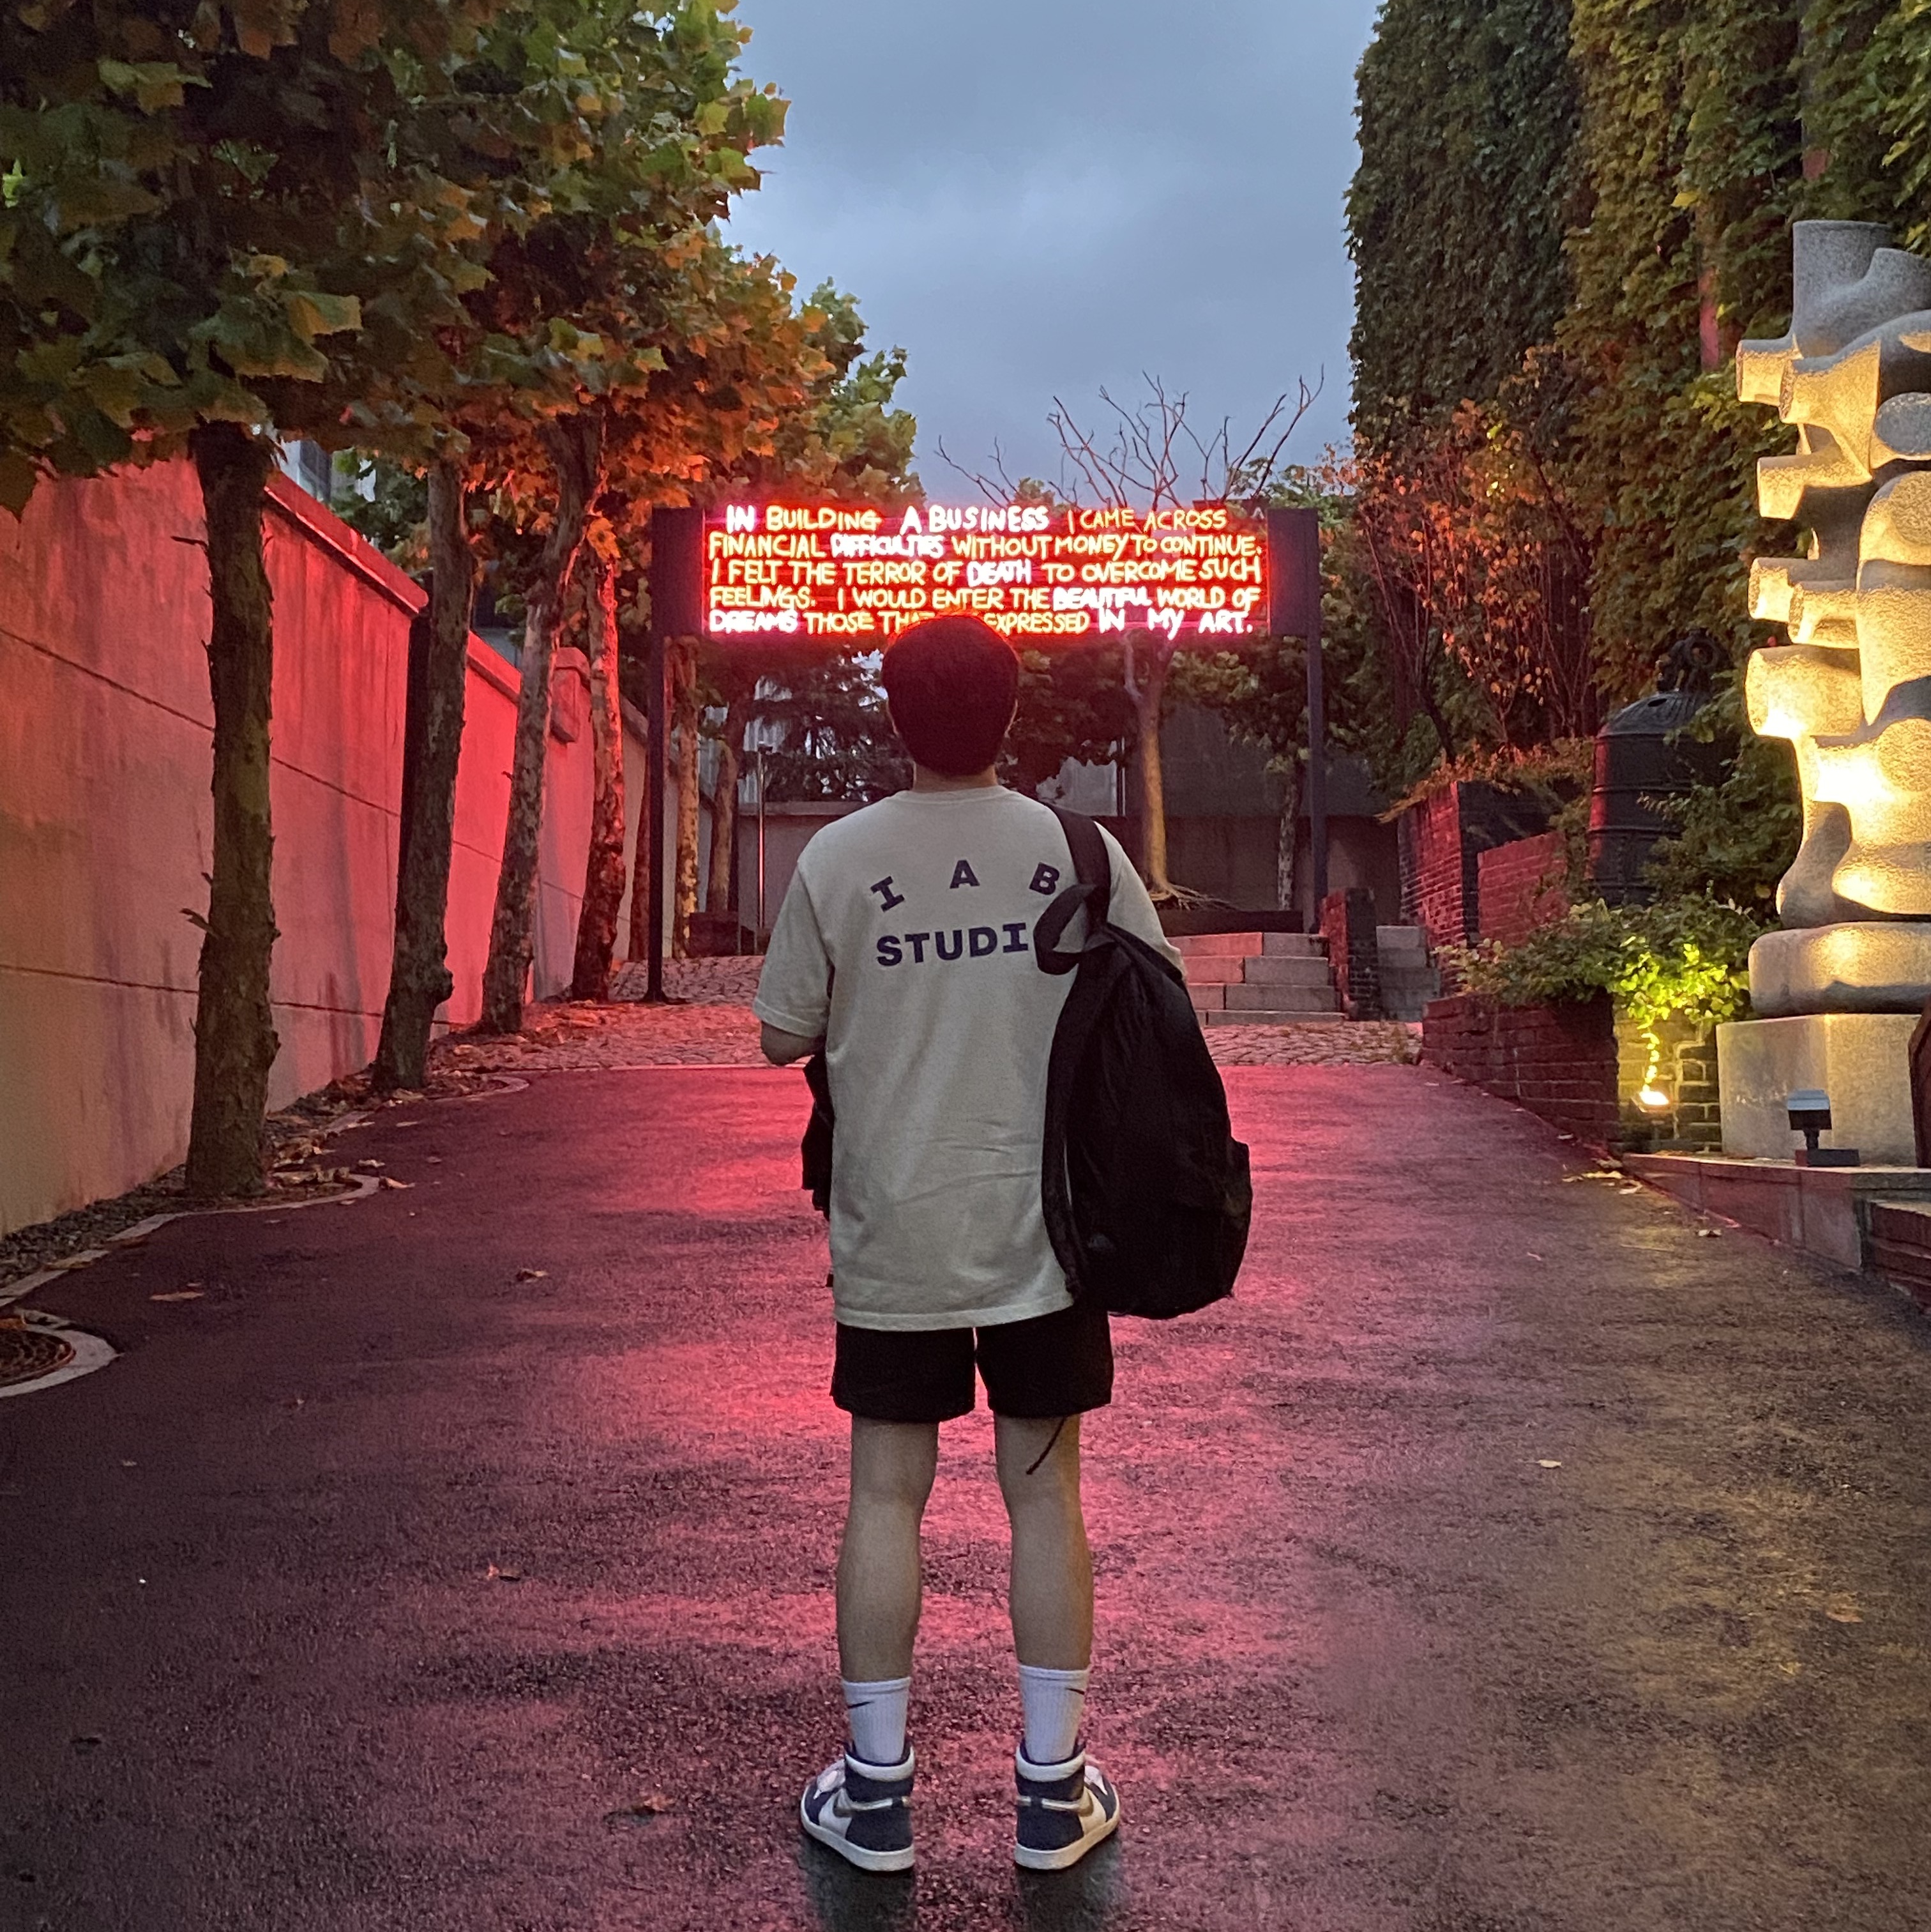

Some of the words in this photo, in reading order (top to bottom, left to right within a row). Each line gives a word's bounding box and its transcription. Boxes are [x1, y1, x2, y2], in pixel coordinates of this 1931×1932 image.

[725, 505, 755, 532] IN
[766, 505, 882, 531] BUILDING
[899, 505, 922, 535] A
[928, 505, 1050, 533] BUSINESS
[1069, 509, 1075, 535] I
[1080, 510, 1135, 529] CAME
[1143, 510, 1227, 531] ACROSS
[708, 531, 826, 560] FINANCIAL
[830, 533, 944, 558] DIFFICULTIES
[951, 535, 1052, 559] WITHOUT
[1055, 532, 1129, 561] MONEY
[1132, 535, 1157, 557] TO
[1161, 534, 1262, 557] CONTINUE.
[711, 561, 719, 584] I
[727, 559, 783, 585] FELT
[788, 561, 837, 586] THE
[842, 562, 926, 586] TERROR
[932, 561, 963, 585] OF
[966, 557, 1032, 586] DEATH
[1041, 563, 1074, 583] TO
[1082, 559, 1197, 584] OVERCOME
[1199, 558, 1262, 584] SUCH
[710, 586, 815, 610] FEELINGS.
[837, 587, 844, 611] I
[853, 589, 927, 609] WOULD
[932, 589, 1004, 609] ENTER
[1009, 588, 1050, 611] THE
[1053, 586, 1152, 611] BEAUTIFUL
[1156, 587, 1225, 609] WORLD
[1231, 588, 1261, 612] OF
[710, 609, 798, 634] DREAMS
[803, 612, 875, 634] THOSE
[877, 612, 935, 634] TH
[1099, 608, 1125, 633] IN
[1147, 608, 1184, 640] MY
[1199, 610, 1253, 634] ART.
[877, 922, 1029, 966] STUDI
